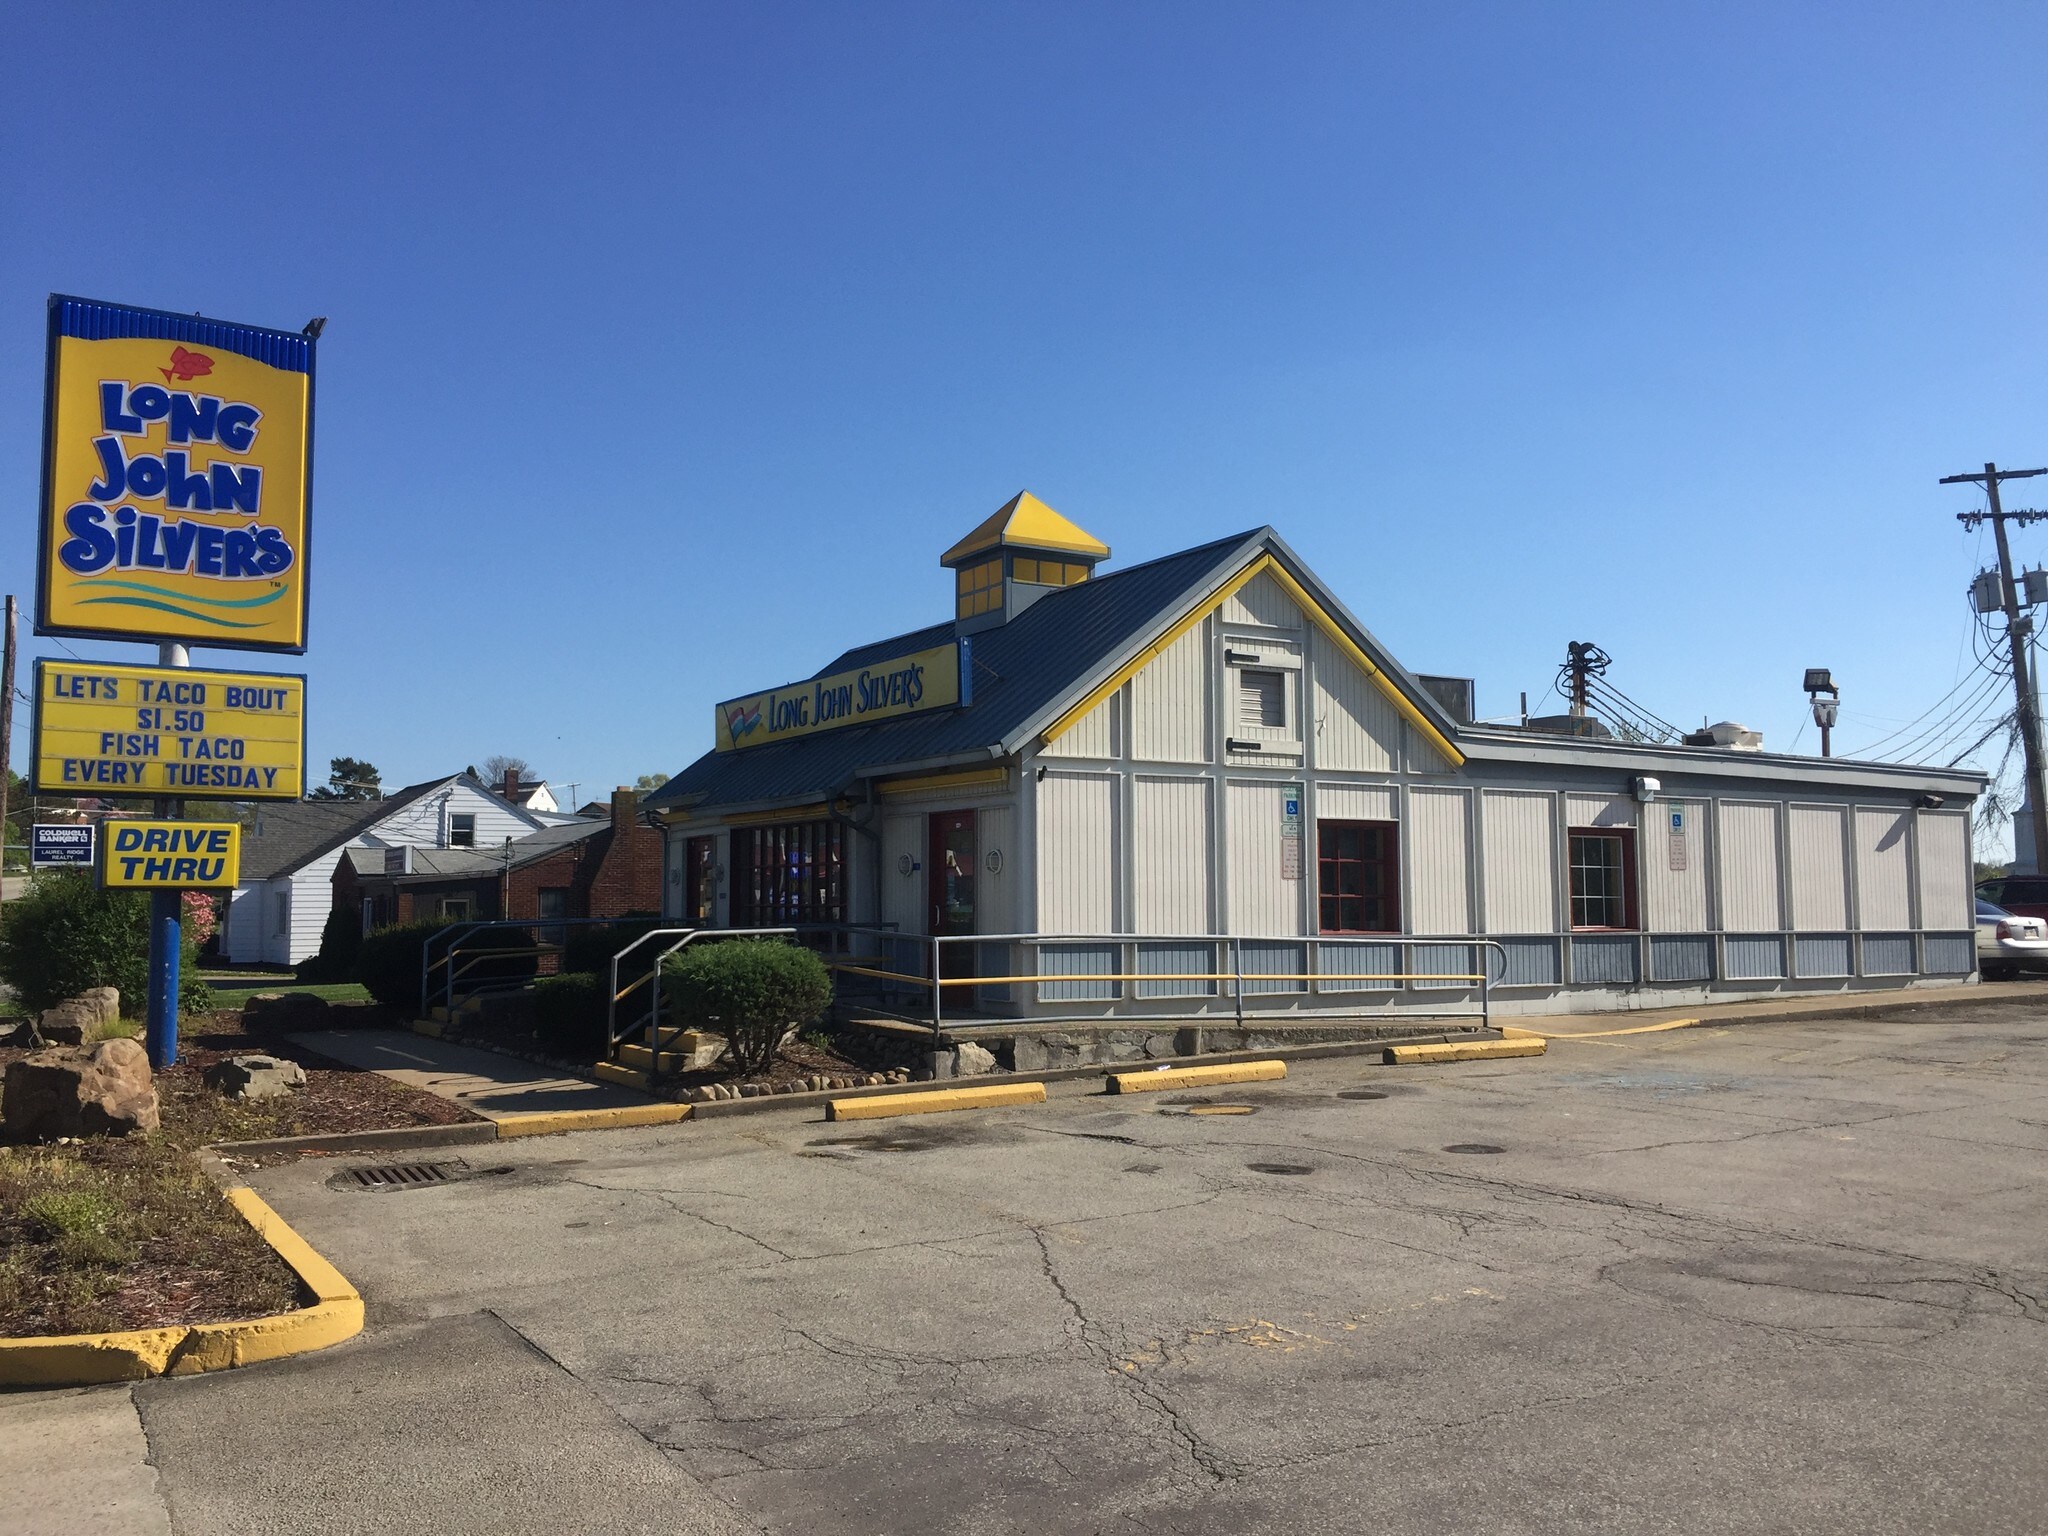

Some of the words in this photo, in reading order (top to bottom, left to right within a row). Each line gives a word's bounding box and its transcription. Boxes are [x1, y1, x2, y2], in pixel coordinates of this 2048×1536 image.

[101, 382, 260, 451] LONG
[55, 674, 118, 700] LETS
[139, 679, 206, 705] TACO
[226, 686, 288, 710] BOUT
[768, 694, 808, 733] LONG
[811, 682, 853, 727] JOHN
[856, 662, 924, 713] SILVER'S
[101, 732, 159, 757] FISH
[179, 737, 245, 760] TACO
[62, 759, 146, 784] EVERY
[165, 763, 278, 789] TUESDAY
[115, 828, 231, 853] DRIVE
[119, 857, 225, 881] THRU
